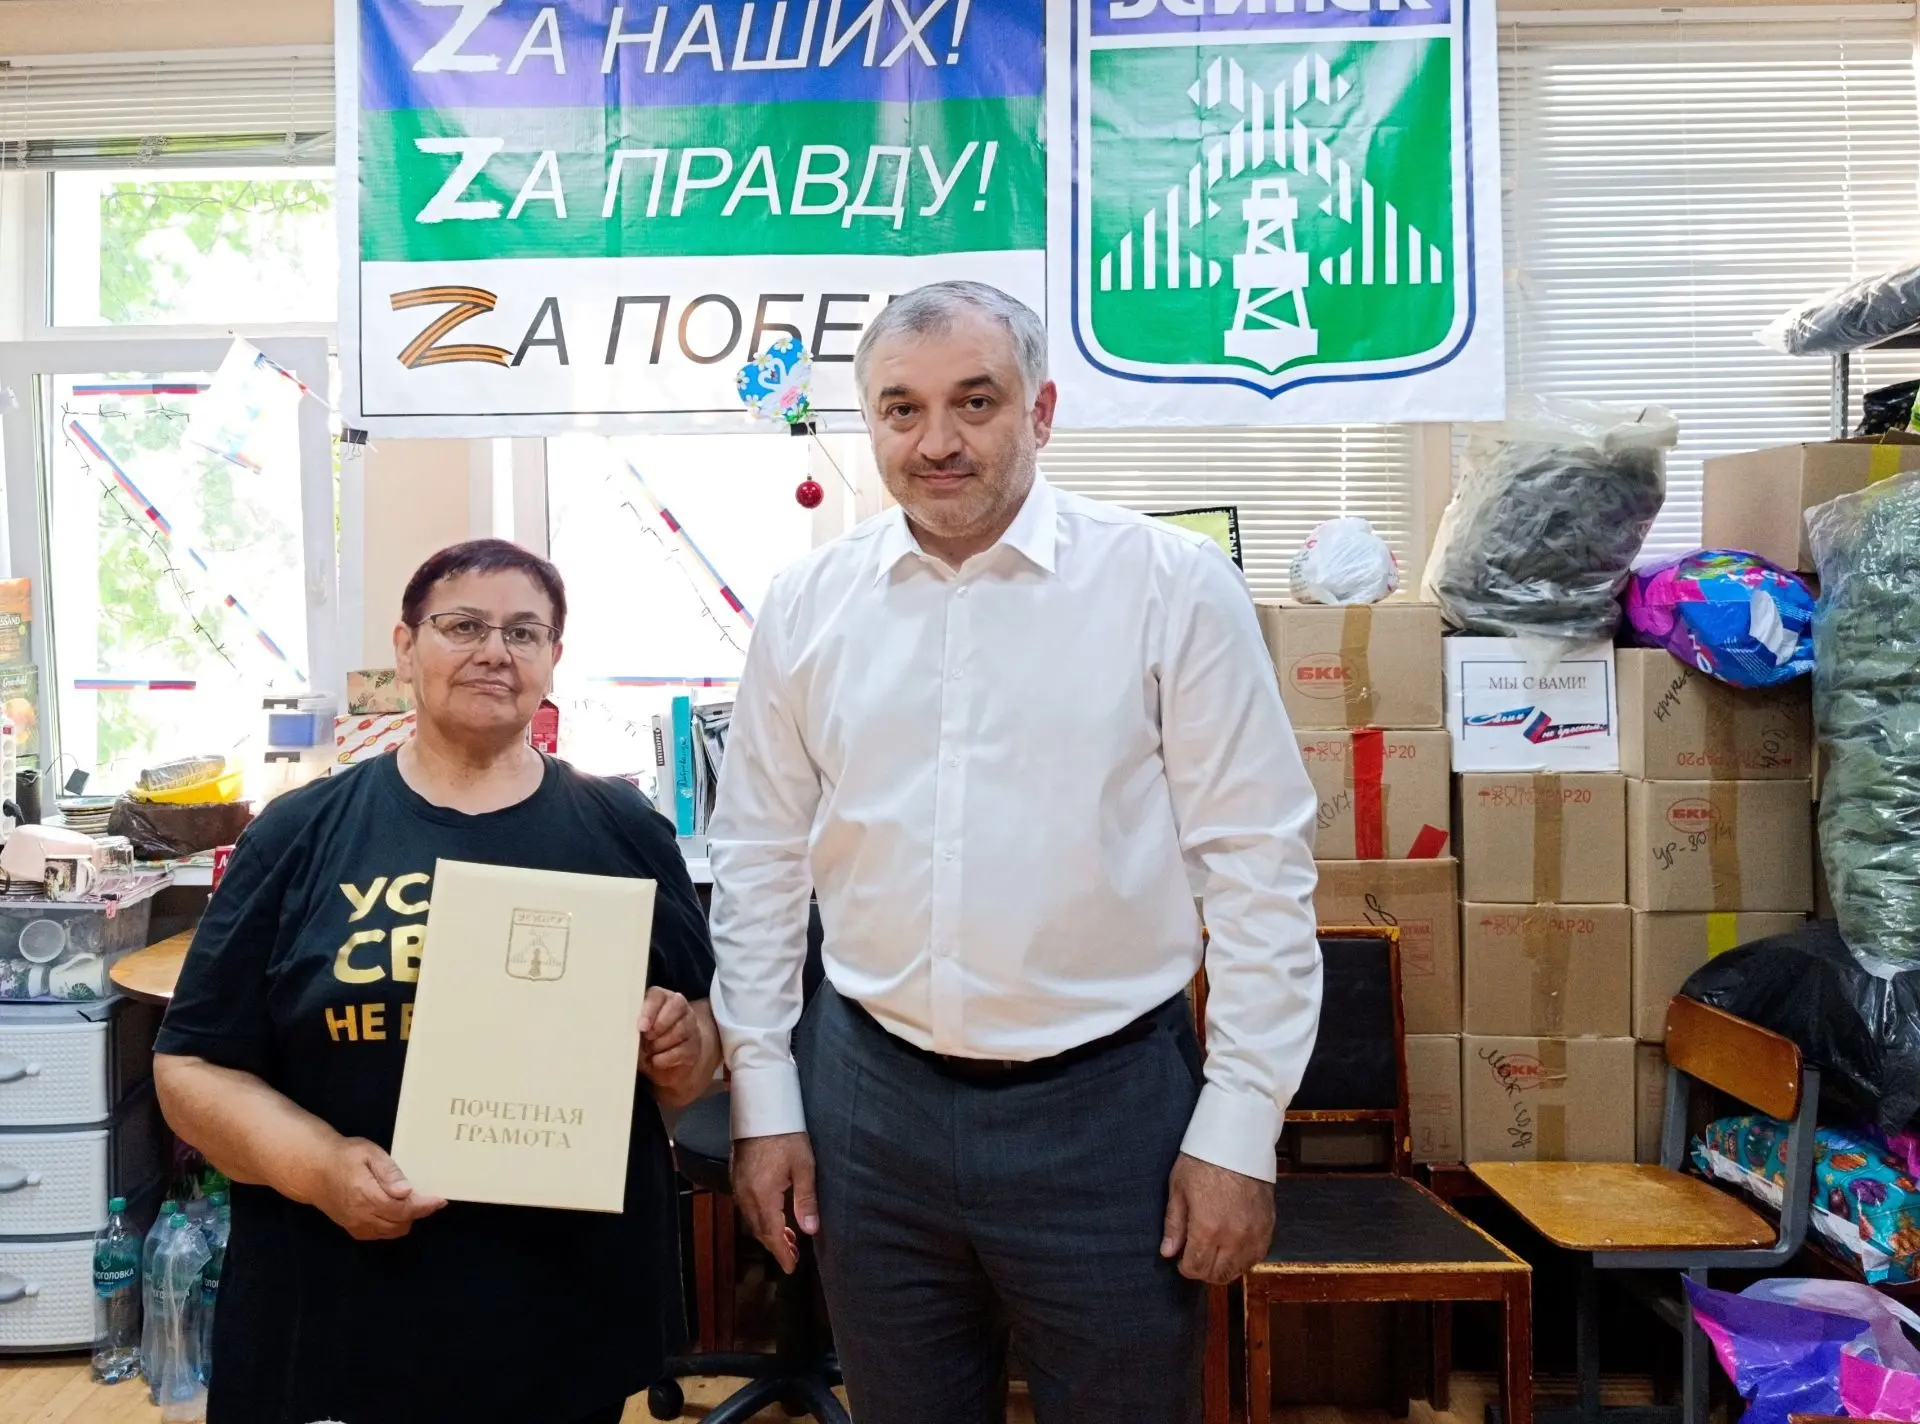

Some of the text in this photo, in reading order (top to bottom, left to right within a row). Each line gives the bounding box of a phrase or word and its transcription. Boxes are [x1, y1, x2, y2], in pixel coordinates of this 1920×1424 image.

[601, 0, 972, 74] НАШИХ!
[414, 136, 999, 230] ZА ПРАВДУ!
[389, 285, 901, 369] ZА ПОБЕ
[1296, 667, 1353, 681] БКК
[1489, 676, 1588, 690] МЫ С ВАМИ!
[1381, 744, 1417, 760] AP20
[1672, 808, 1717, 821] БКК
[339, 872, 431, 923] УС
[333, 923, 428, 984] СВ
[325, 1003, 387, 1042] НЕ
[450, 1097, 585, 1126] ПОЧЕТНАЯ
[455, 1123, 572, 1149] ГРАМОТА
